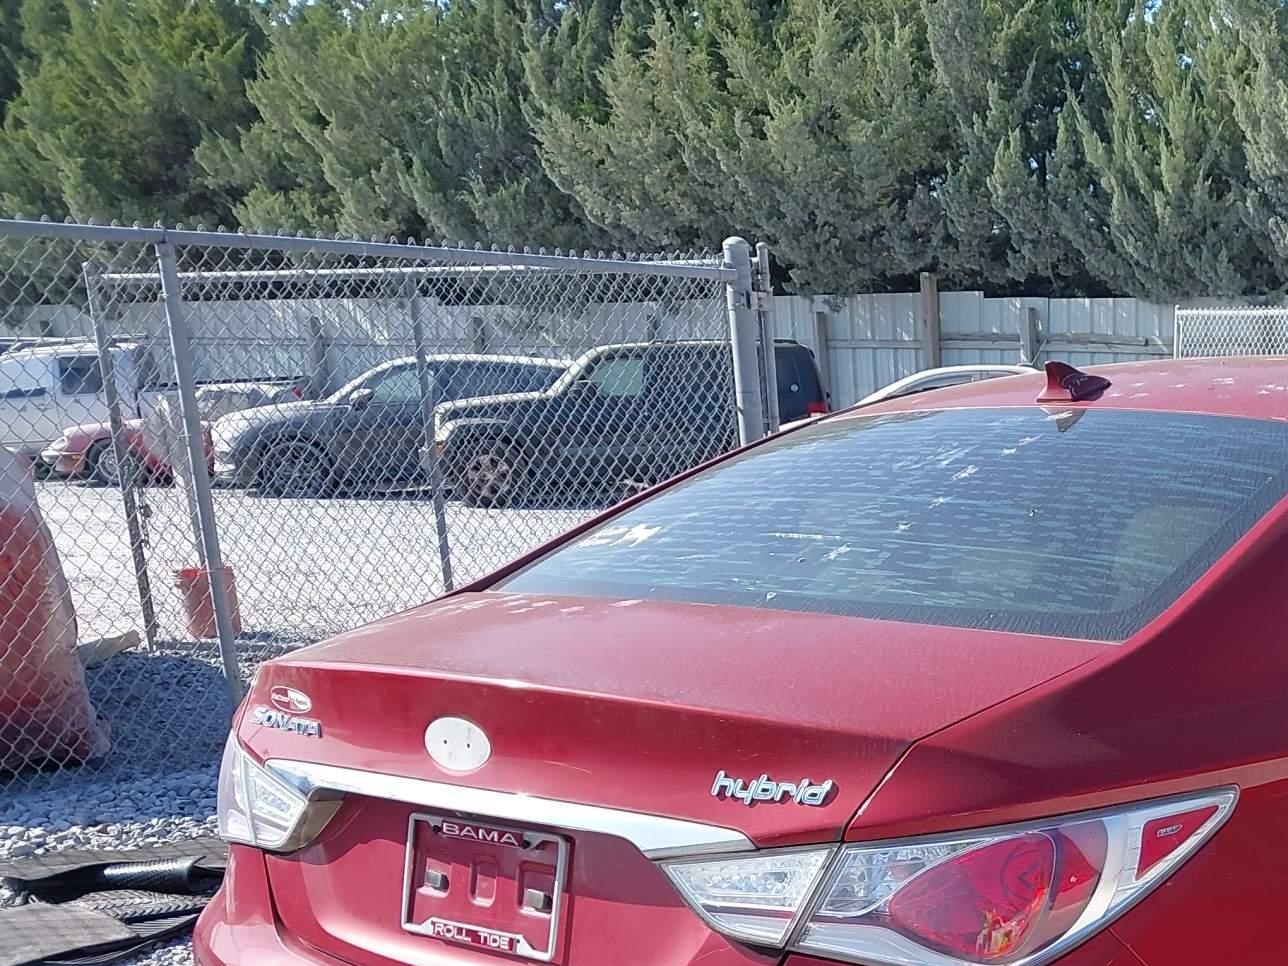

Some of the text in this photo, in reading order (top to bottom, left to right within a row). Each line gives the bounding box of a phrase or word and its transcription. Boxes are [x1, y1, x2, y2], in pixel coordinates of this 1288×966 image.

[250, 706, 322, 738] SONATA
[710, 770, 836, 806] hybrid
[442, 823, 519, 846] BAMA
[434, 923, 511, 950] ROLL TIDE
